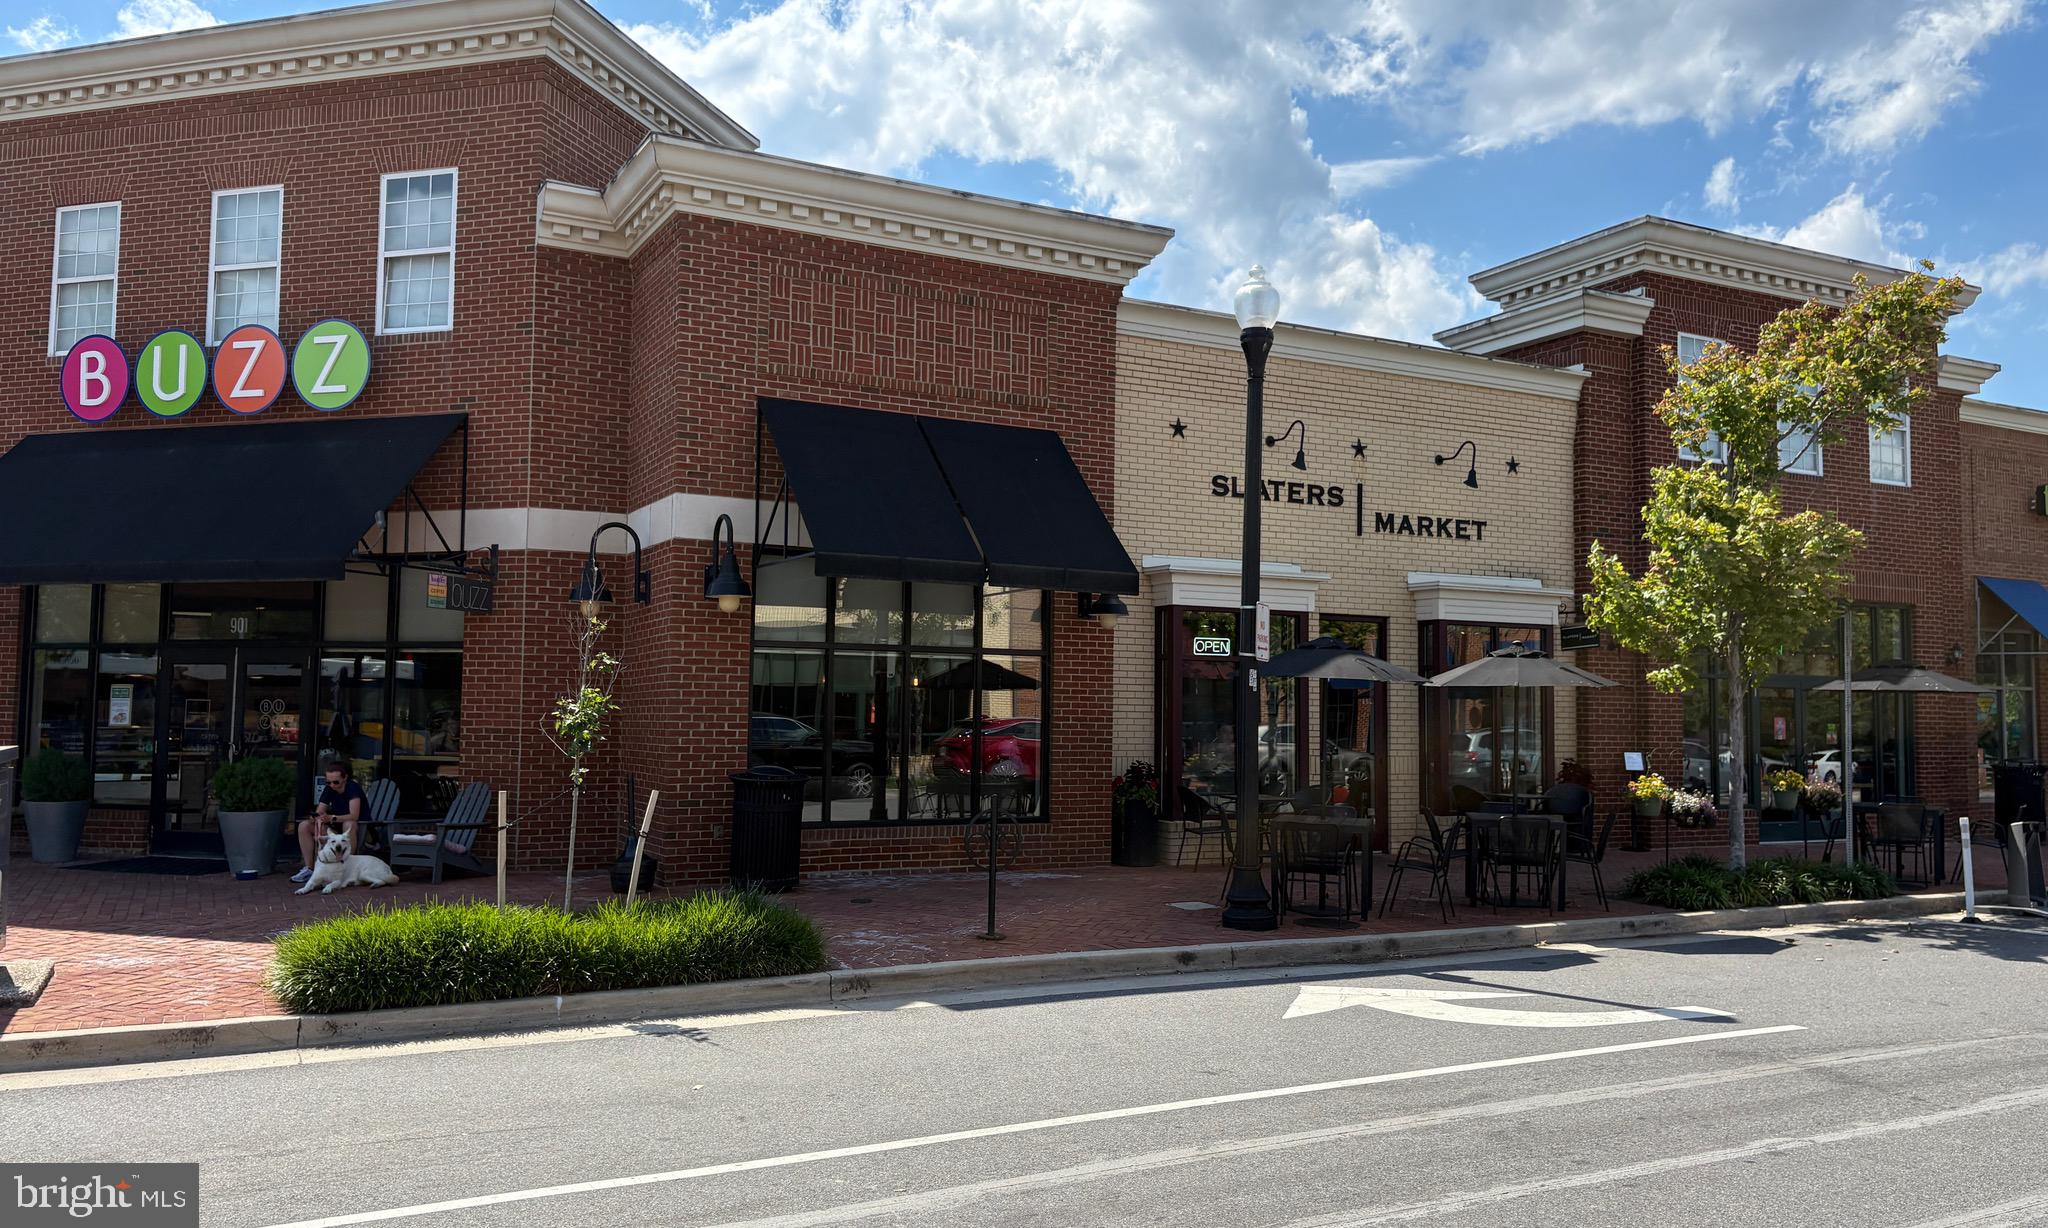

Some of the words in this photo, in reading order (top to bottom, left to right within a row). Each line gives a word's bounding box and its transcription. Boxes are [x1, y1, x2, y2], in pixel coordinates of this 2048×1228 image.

[79, 334, 350, 408] BUZZ
[1211, 474, 1345, 508] SLATERS
[1374, 511, 1488, 541] MARKET
[451, 575, 489, 611] buzz
[230, 617, 248, 634] 901
[1195, 640, 1229, 653] OPEN
